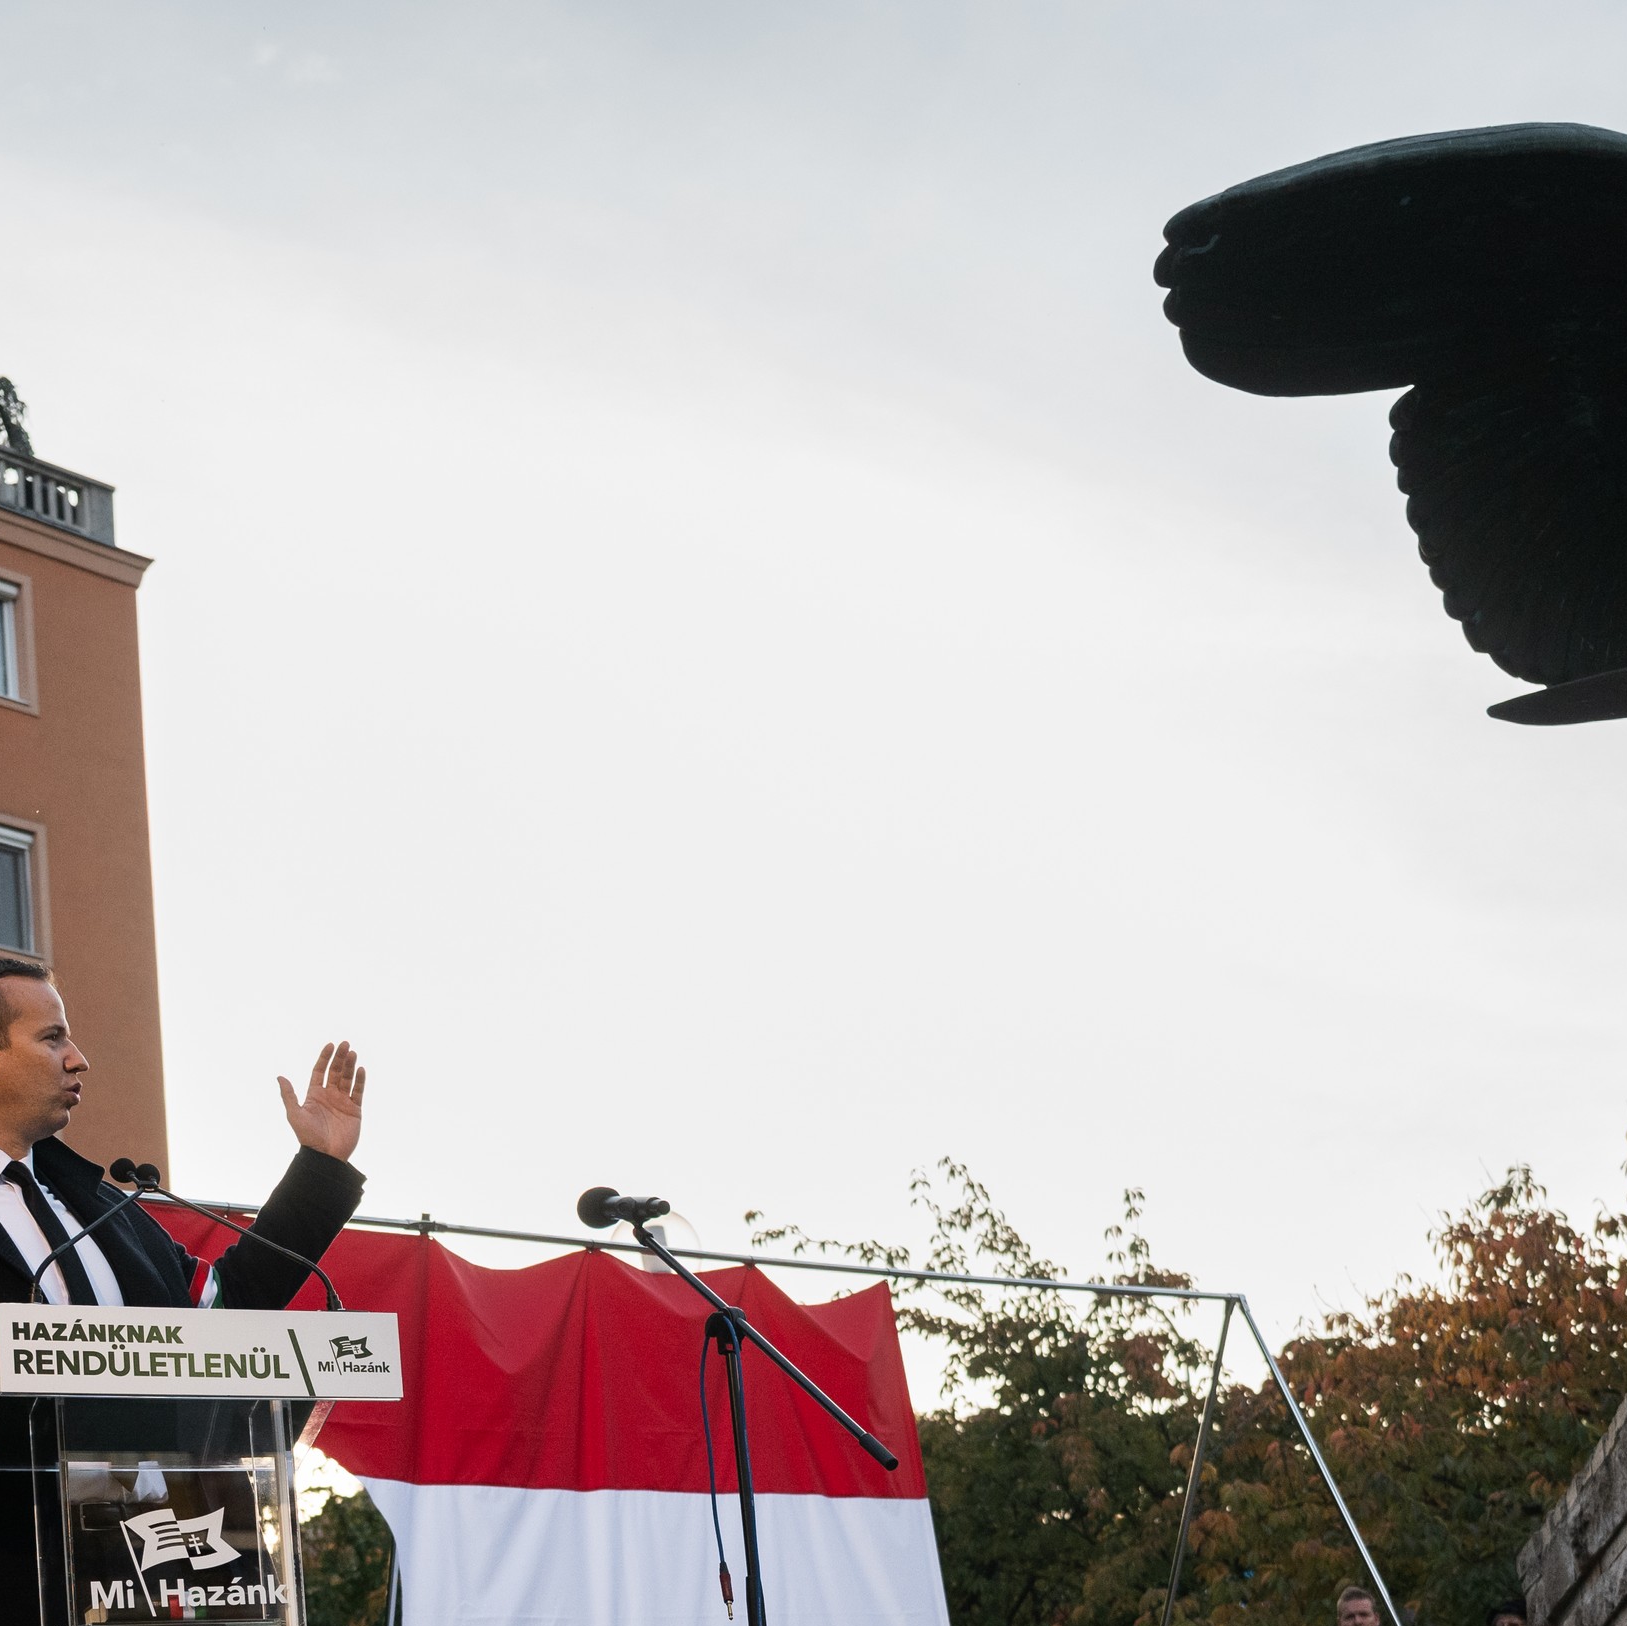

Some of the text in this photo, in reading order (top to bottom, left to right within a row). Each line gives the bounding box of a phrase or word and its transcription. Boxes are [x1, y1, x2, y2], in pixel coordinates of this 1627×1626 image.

[11, 1319, 184, 1345] HAZÁNKNAK
[12, 1344, 290, 1380] RENDÜLETLENÜL
[317, 1359, 391, 1375] Mi Hazánk
[90, 1574, 290, 1610] Mi Hazánk
